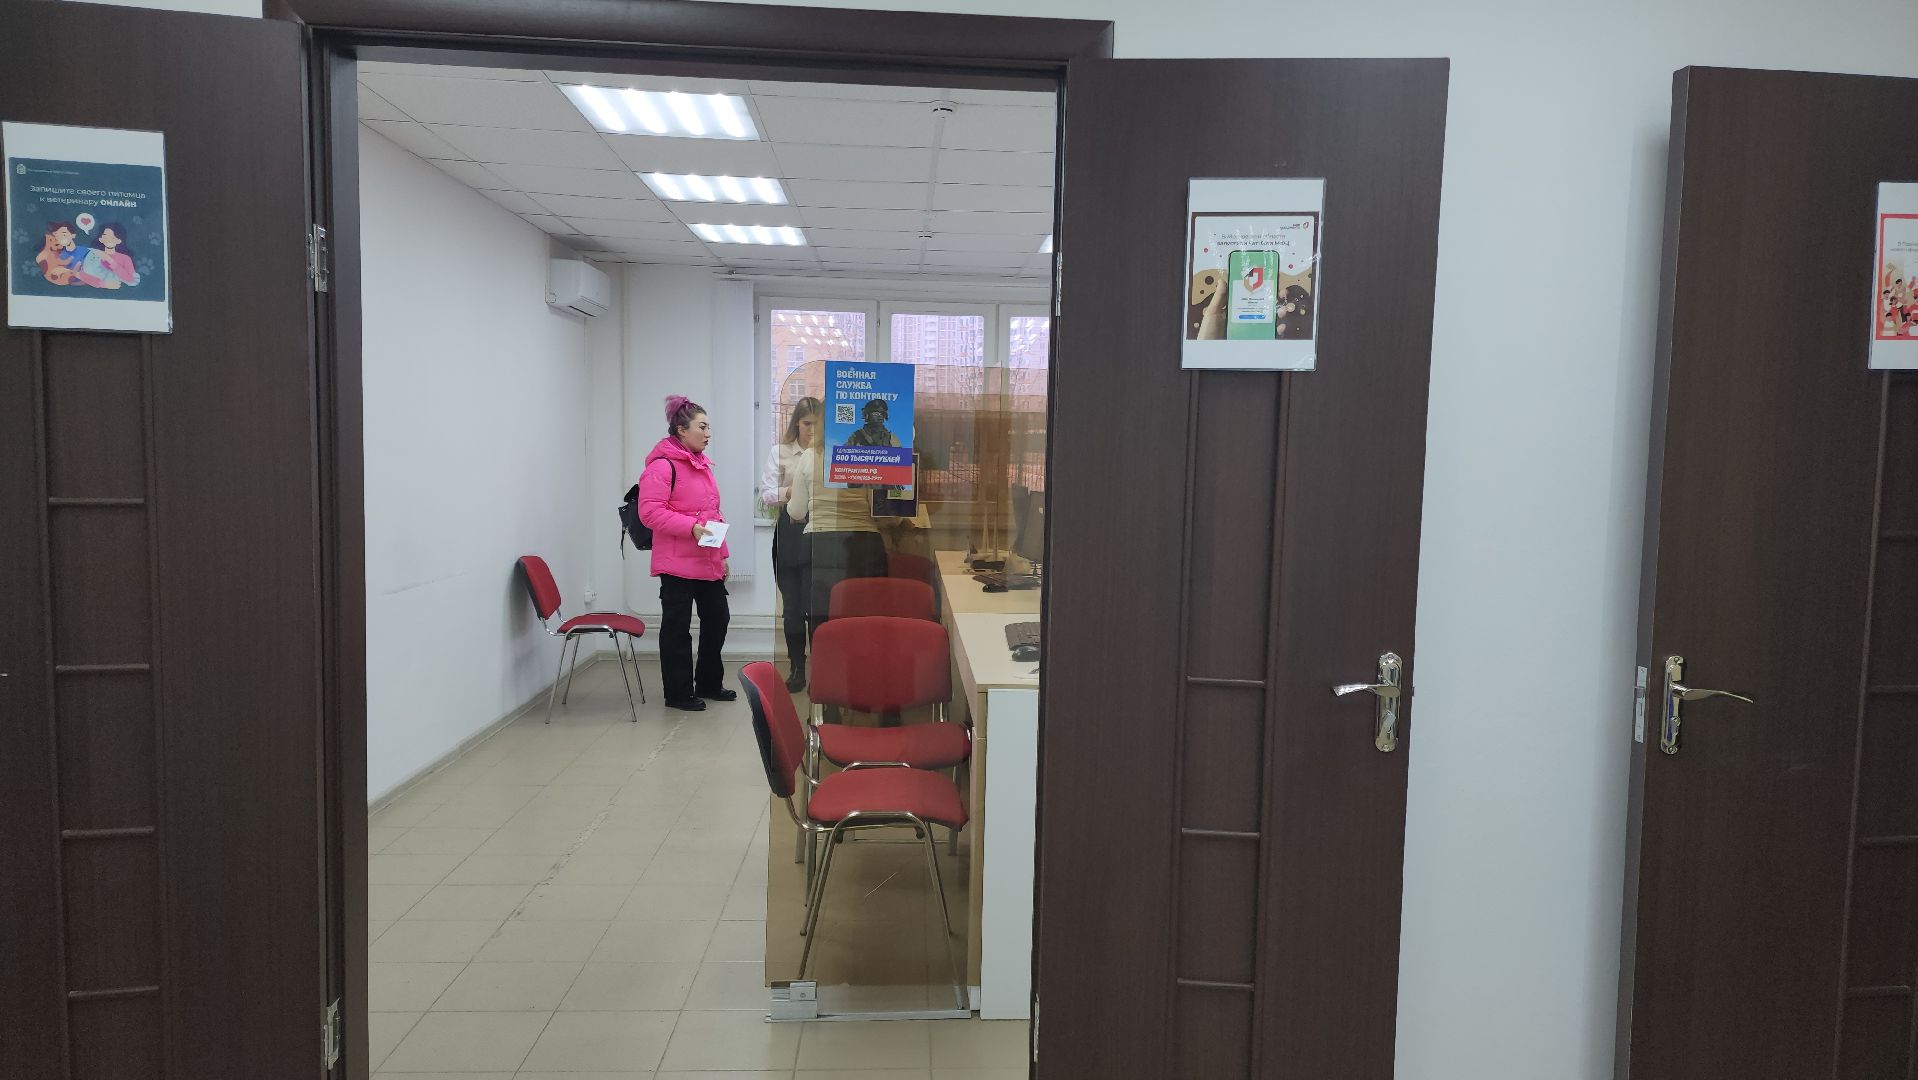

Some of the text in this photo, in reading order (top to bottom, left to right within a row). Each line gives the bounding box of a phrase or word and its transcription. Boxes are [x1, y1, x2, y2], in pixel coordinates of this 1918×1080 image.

[30, 185, 146, 199] Запишите своего питомца
[47, 198, 98, 207] ветеринару
[100, 199, 137, 208] ОНЛАЙН
[836, 370, 877, 380] ВОЕННАЯ
[836, 380, 872, 390] СЛУЖБА
[835, 390, 899, 402] ПО КОНТРАКТУ
[835, 454, 901, 464] 600 ТЫСЯЧ РУБЛЕЙ
